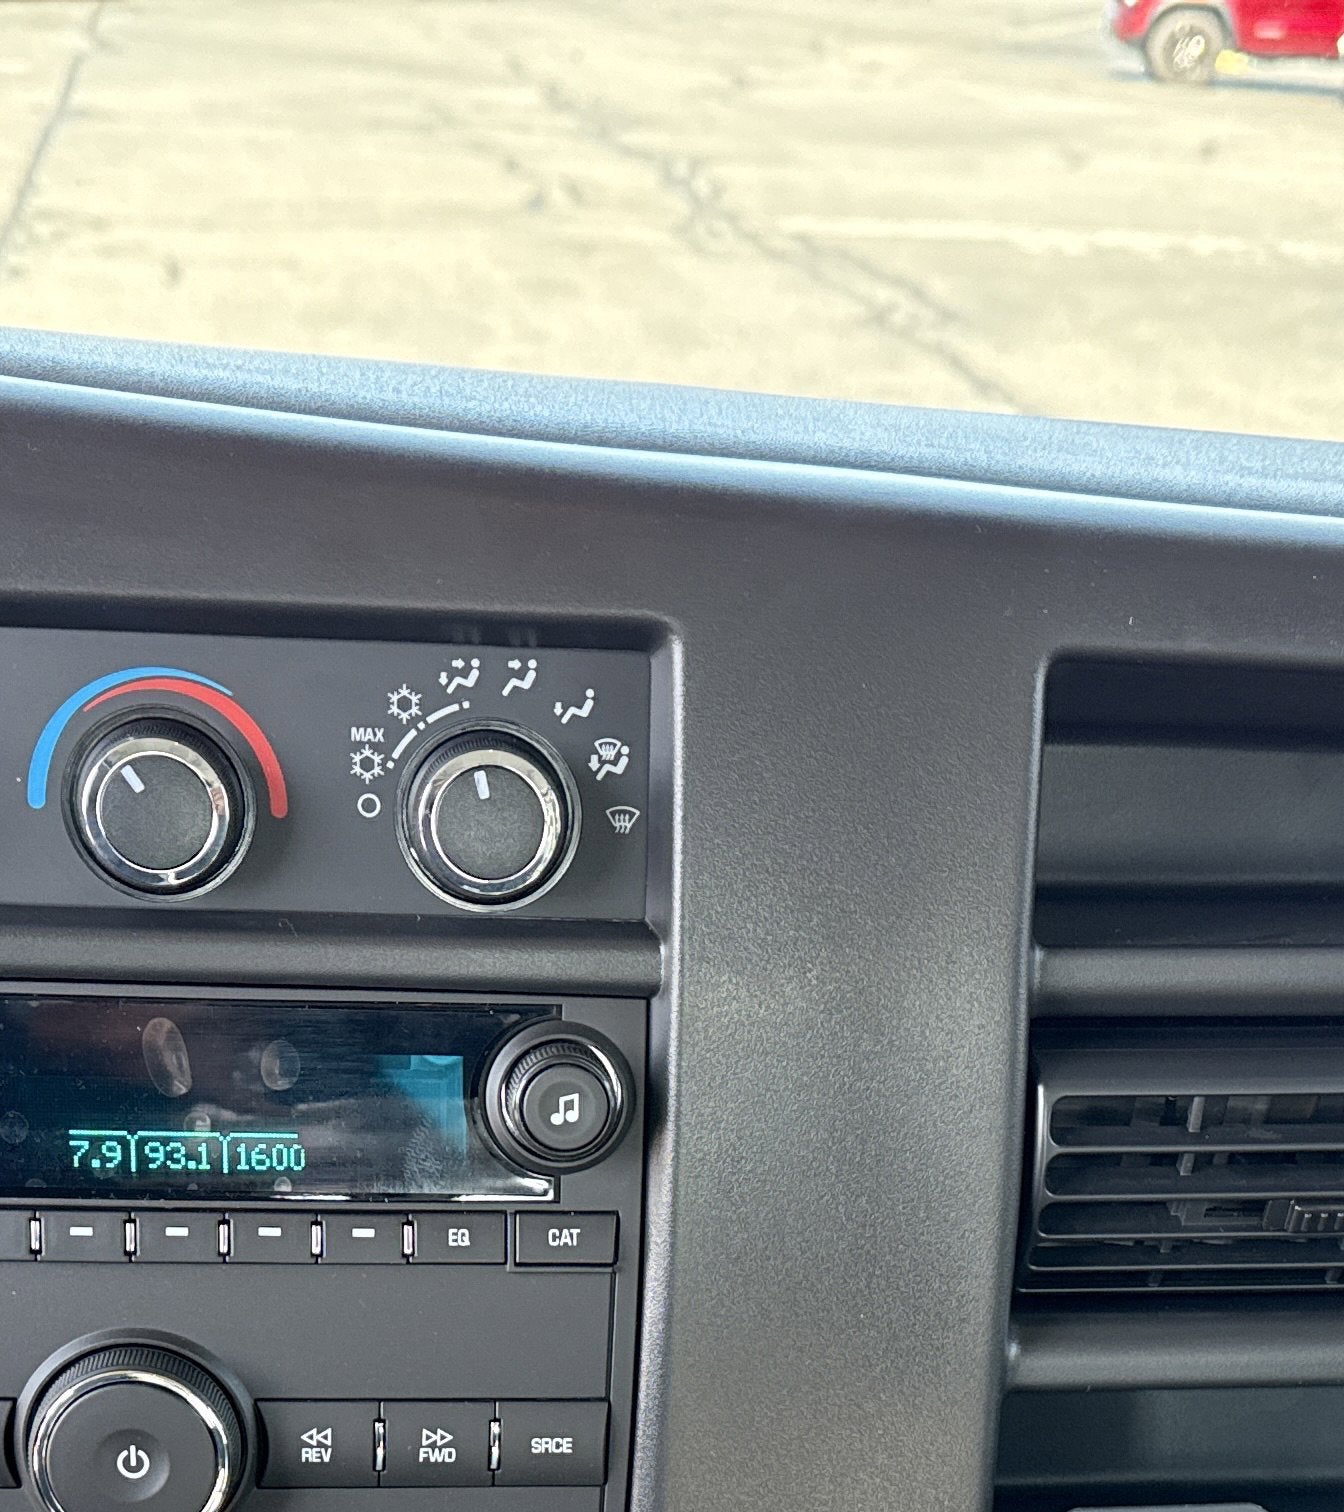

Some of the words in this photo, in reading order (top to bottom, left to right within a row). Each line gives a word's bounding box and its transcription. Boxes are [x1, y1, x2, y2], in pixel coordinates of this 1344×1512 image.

[350, 726, 385, 743] MAX
[68, 1140, 122, 1168] 7.9
[144, 1141, 211, 1170] 93.1
[236, 1143, 306, 1171] 1600
[448, 1228, 471, 1247] EQ
[547, 1228, 581, 1247] CAT
[530, 1437, 573, 1454] SRCE
[301, 1446, 333, 1463] REV
[418, 1446, 457, 1463] FWD
